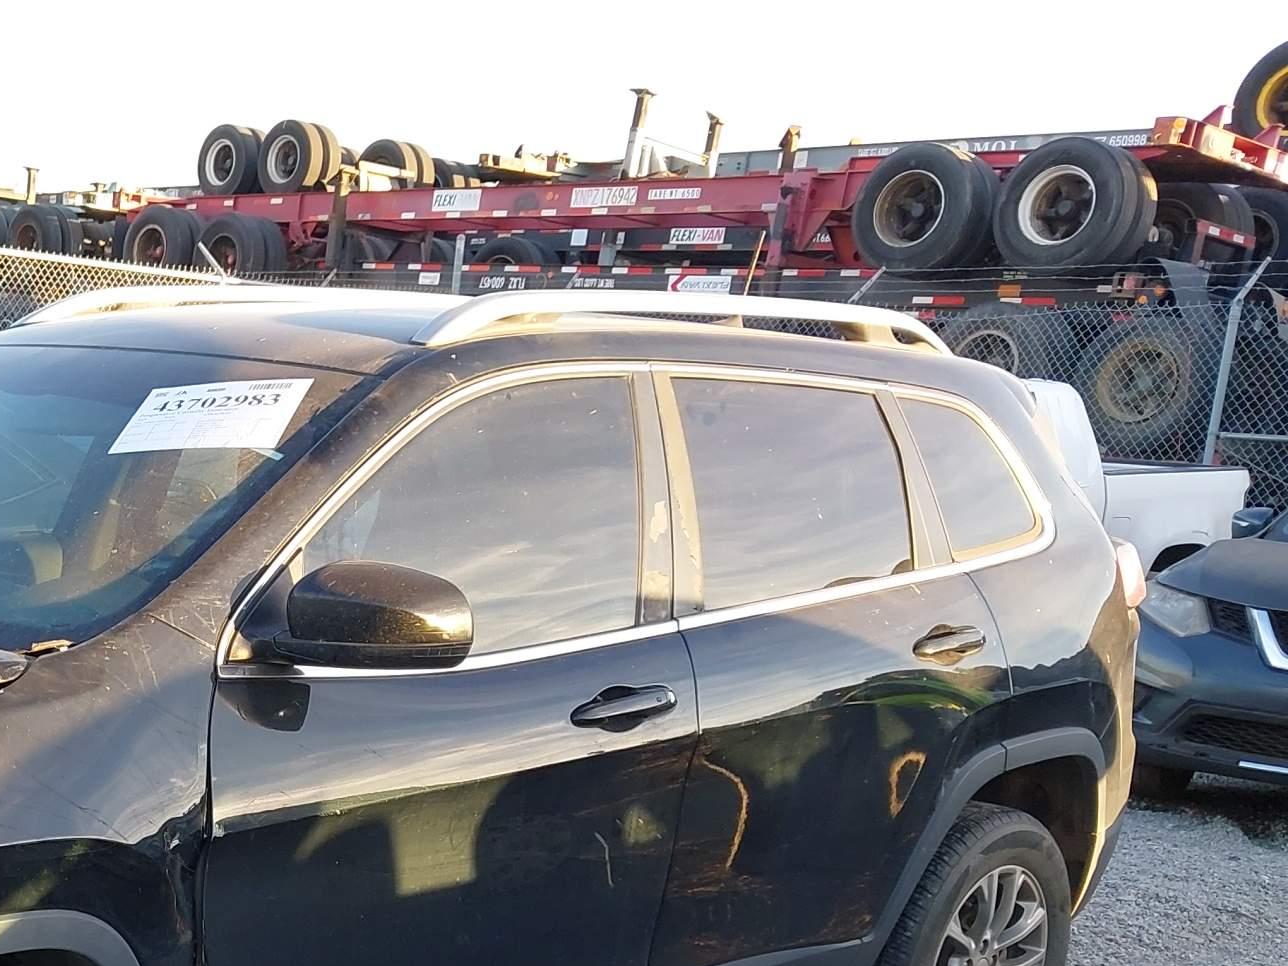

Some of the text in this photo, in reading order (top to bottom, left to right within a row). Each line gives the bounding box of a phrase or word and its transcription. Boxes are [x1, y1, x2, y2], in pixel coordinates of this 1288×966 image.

[1109, 134, 1148, 147] 650998
[671, 228, 724, 242] FLEXI-VAN
[152, 393, 282, 412] 43702983
